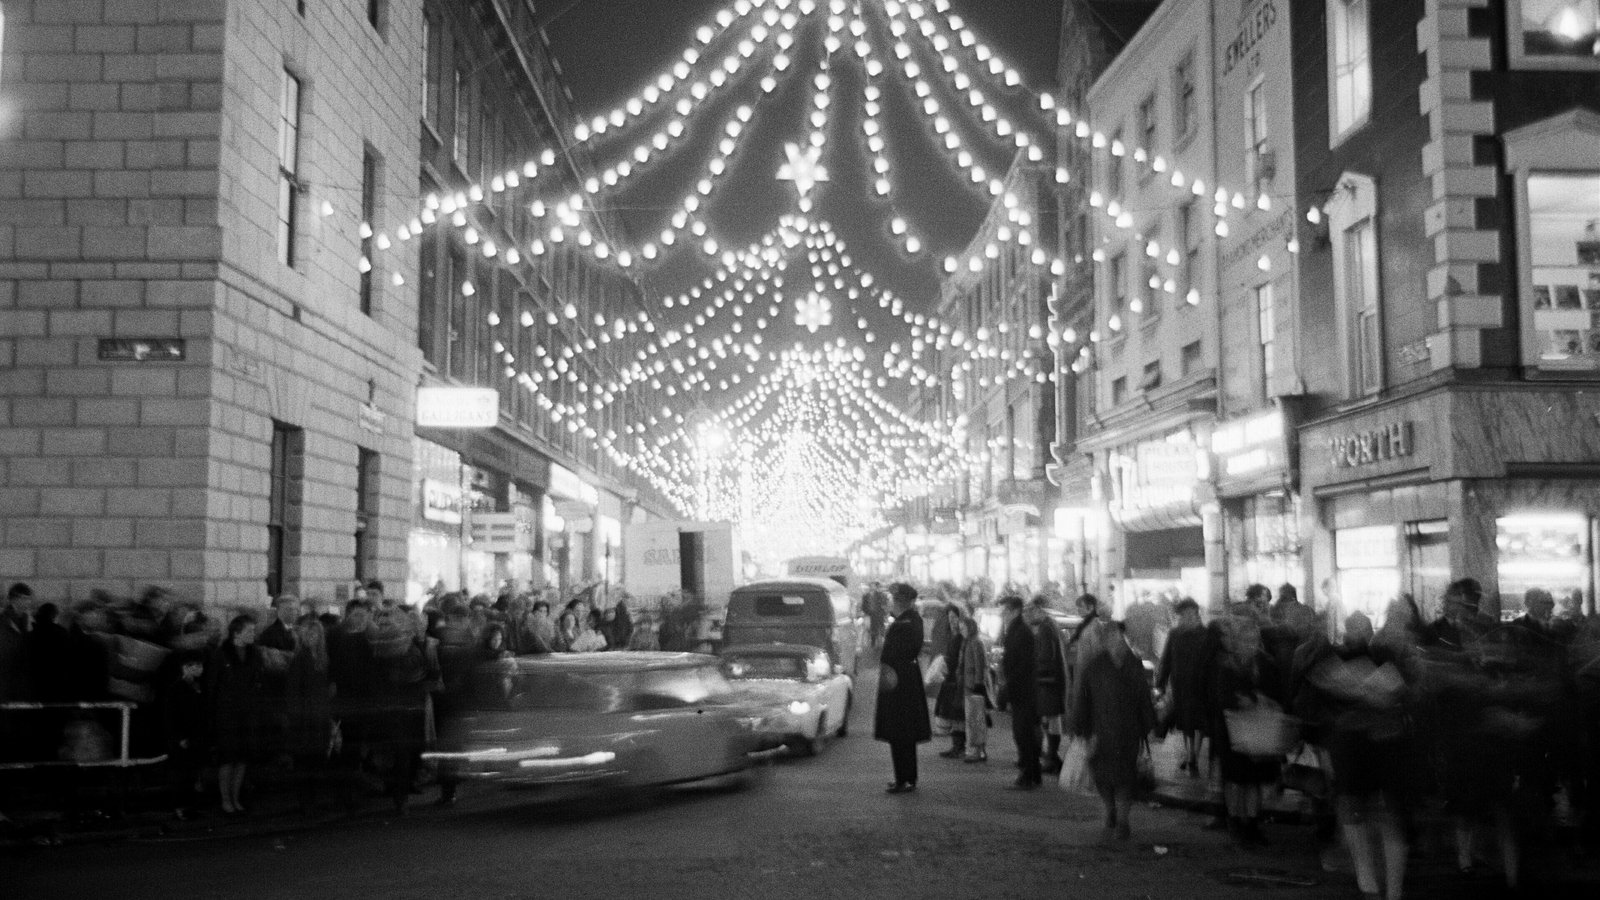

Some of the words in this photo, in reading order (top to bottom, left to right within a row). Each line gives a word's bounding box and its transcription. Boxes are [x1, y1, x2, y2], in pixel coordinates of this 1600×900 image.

[1223, 0, 1277, 77] JEWELLERS
[1327, 420, 1413, 470] WORTH
[795, 563, 849, 574] DUNLOP
